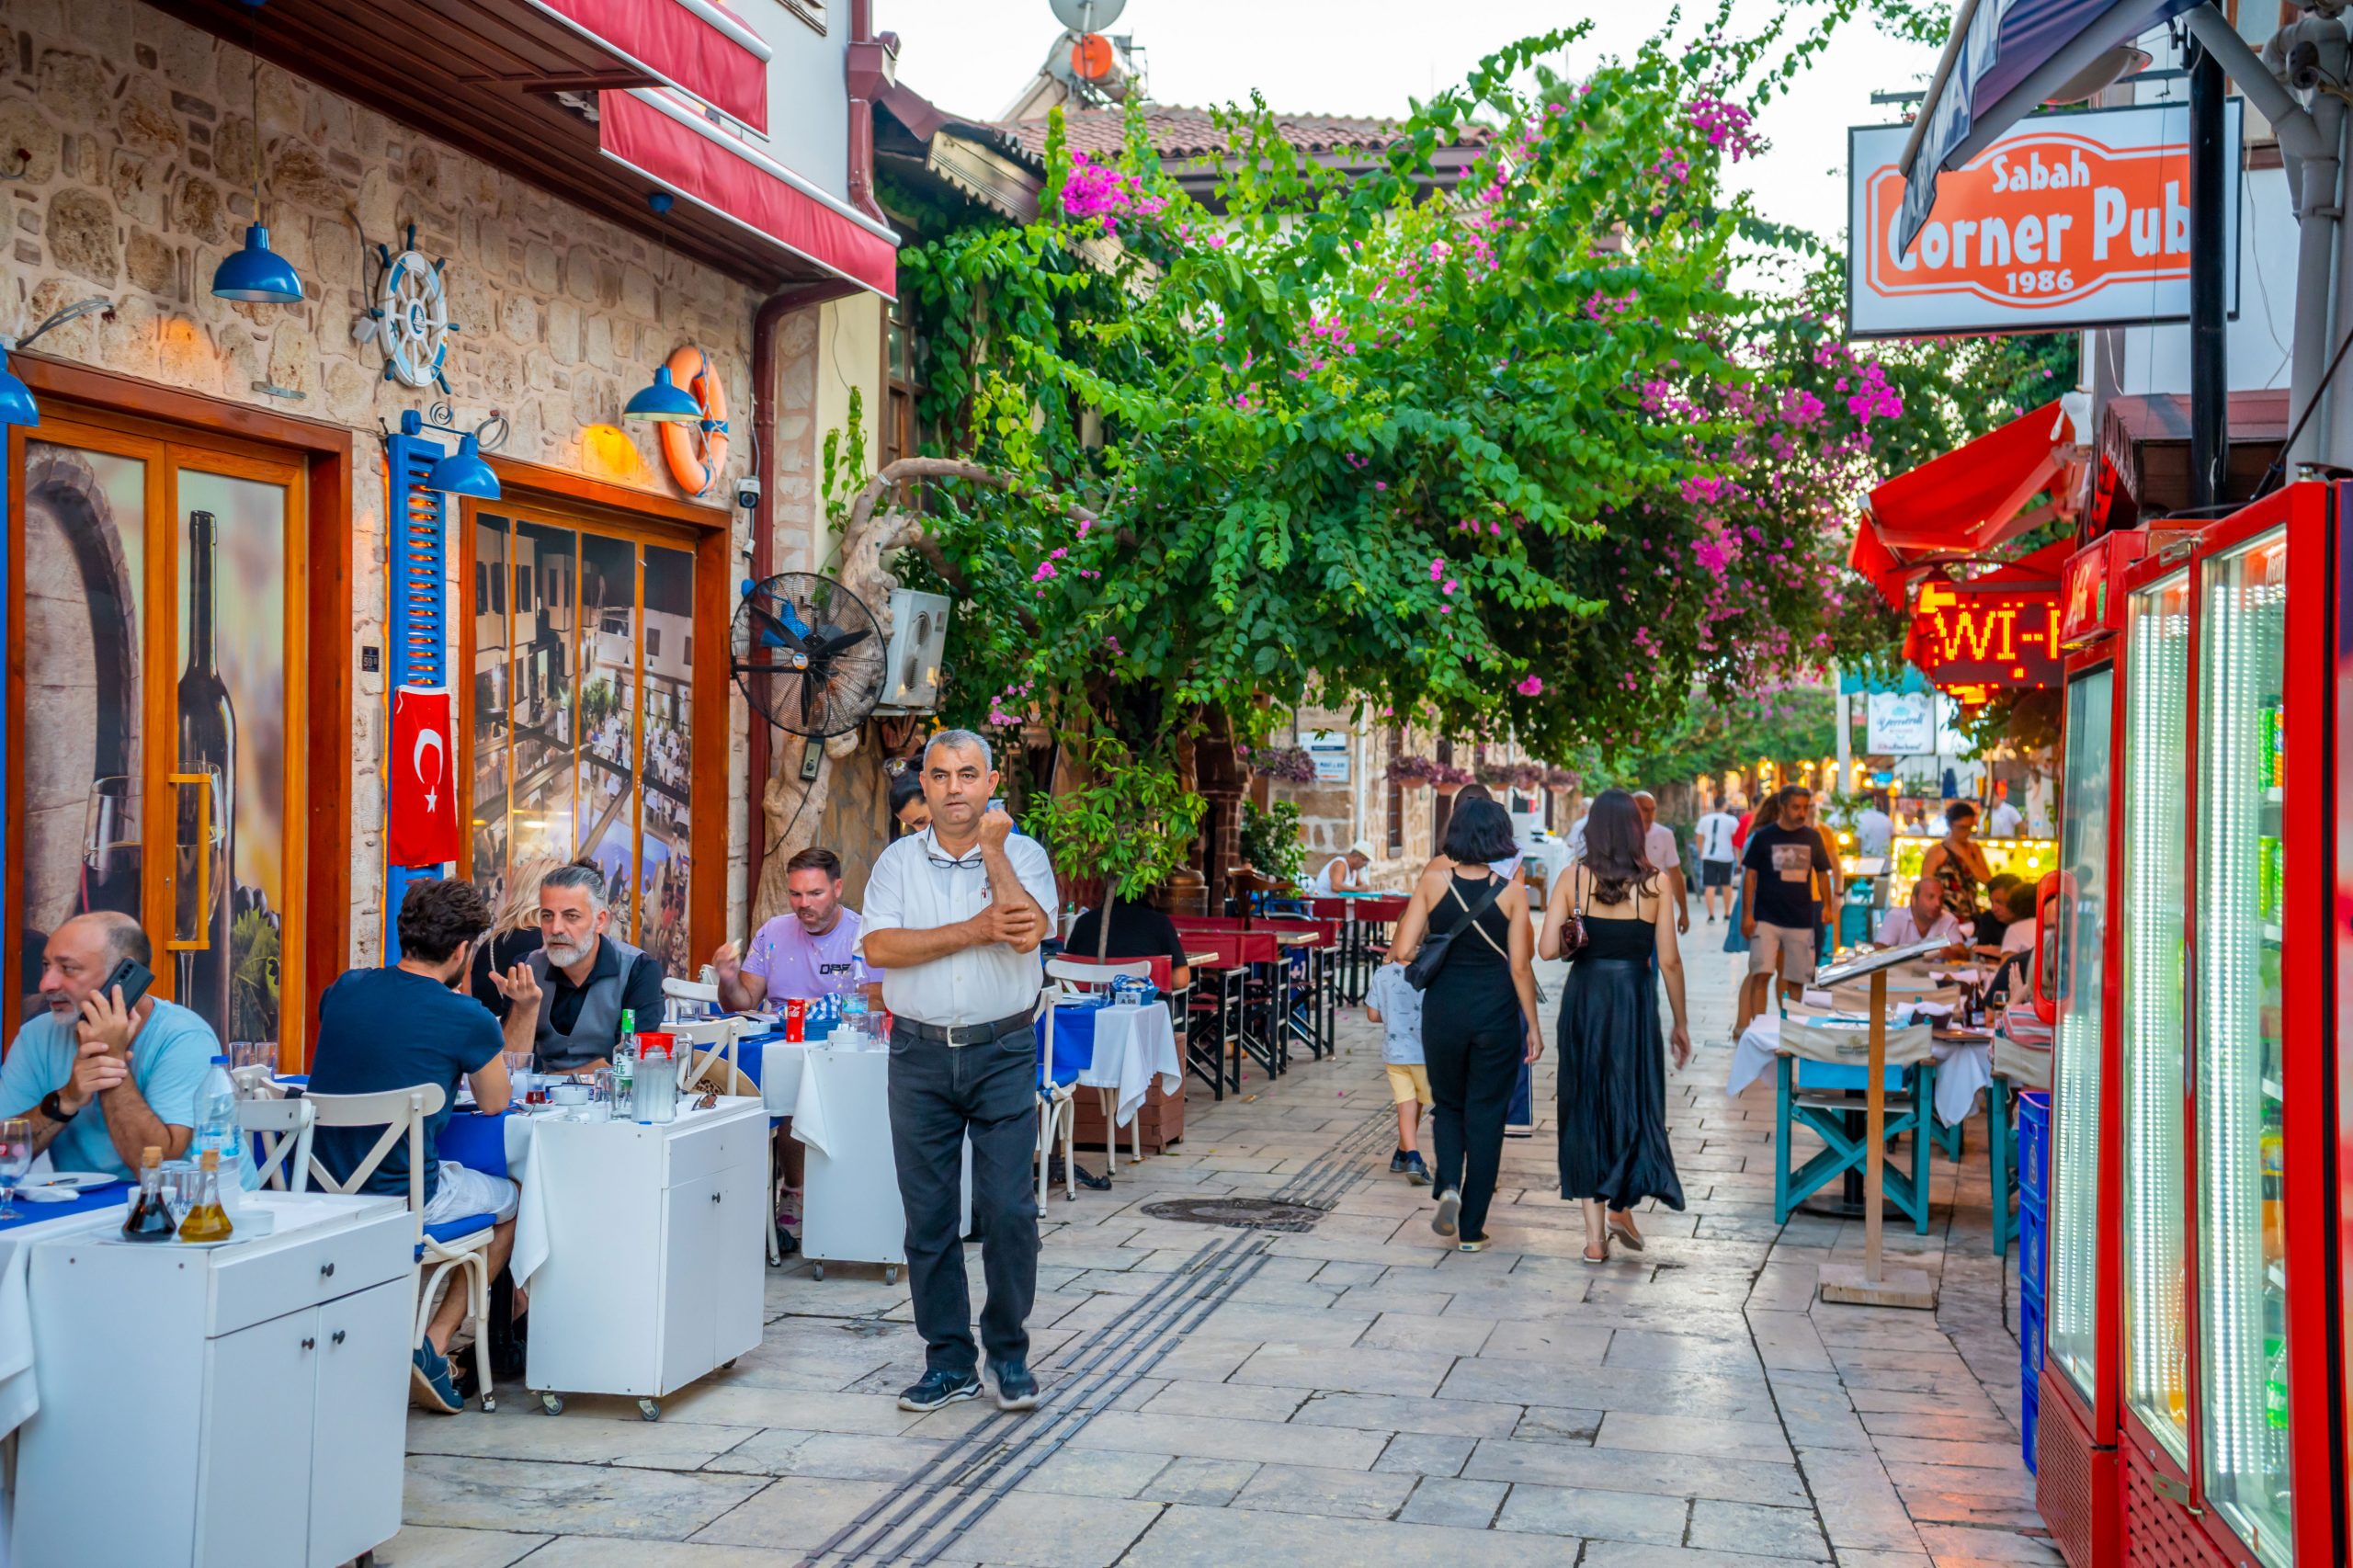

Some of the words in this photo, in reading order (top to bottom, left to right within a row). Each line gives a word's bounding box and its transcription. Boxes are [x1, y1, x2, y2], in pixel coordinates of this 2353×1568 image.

[1992, 149, 2090, 193] Sabah
[1887, 203, 2073, 272] Corner
[2092, 180, 2190, 261] Pub
[2006, 269, 2075, 295] 1986
